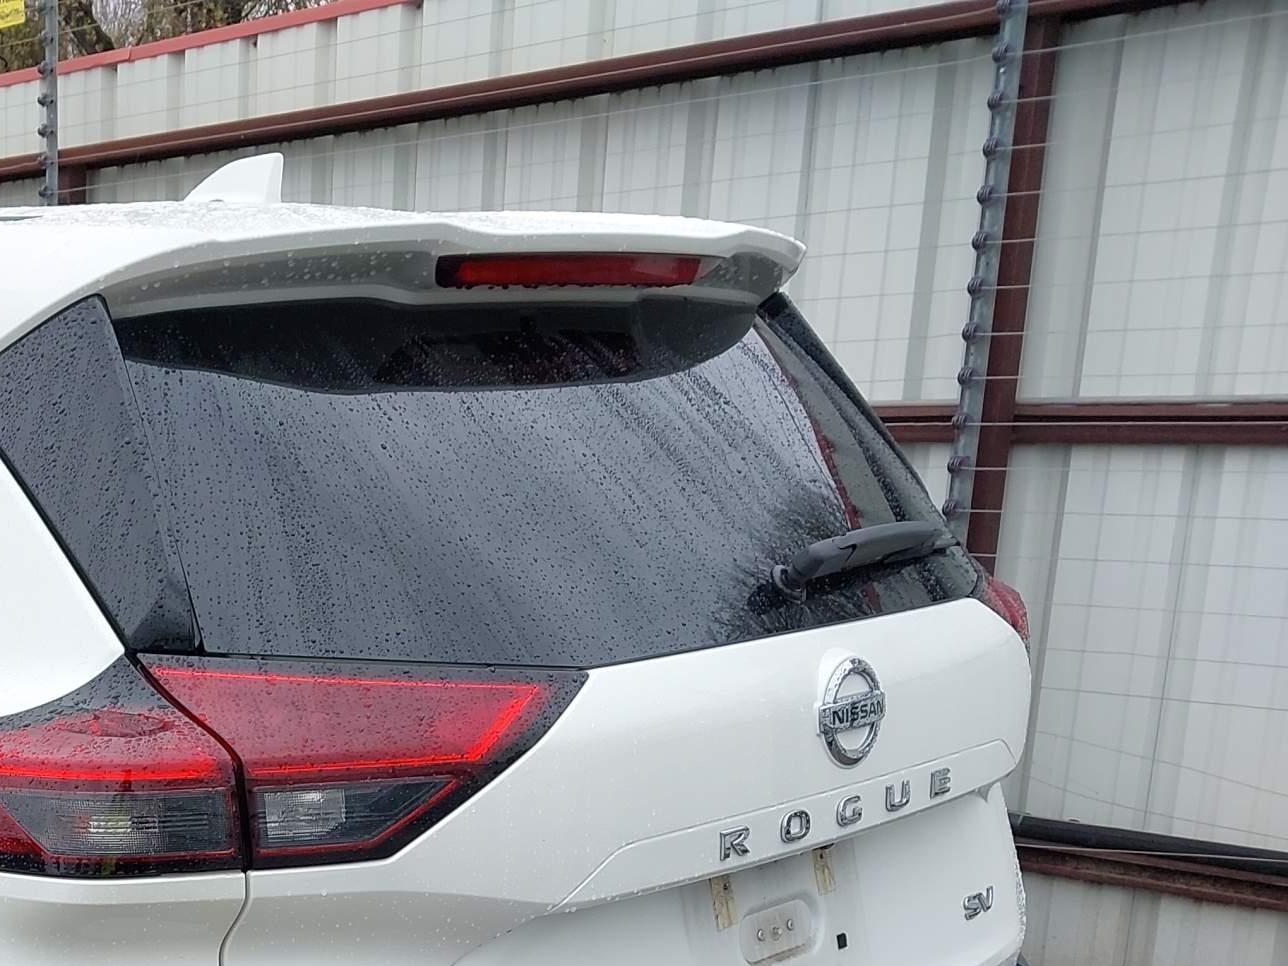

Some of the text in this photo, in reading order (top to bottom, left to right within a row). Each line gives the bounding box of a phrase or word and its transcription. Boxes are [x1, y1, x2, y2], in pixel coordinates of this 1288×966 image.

[831, 700, 885, 726] NISSAN
[719, 767, 952, 861] ROGUE
[962, 886, 994, 920] SV
